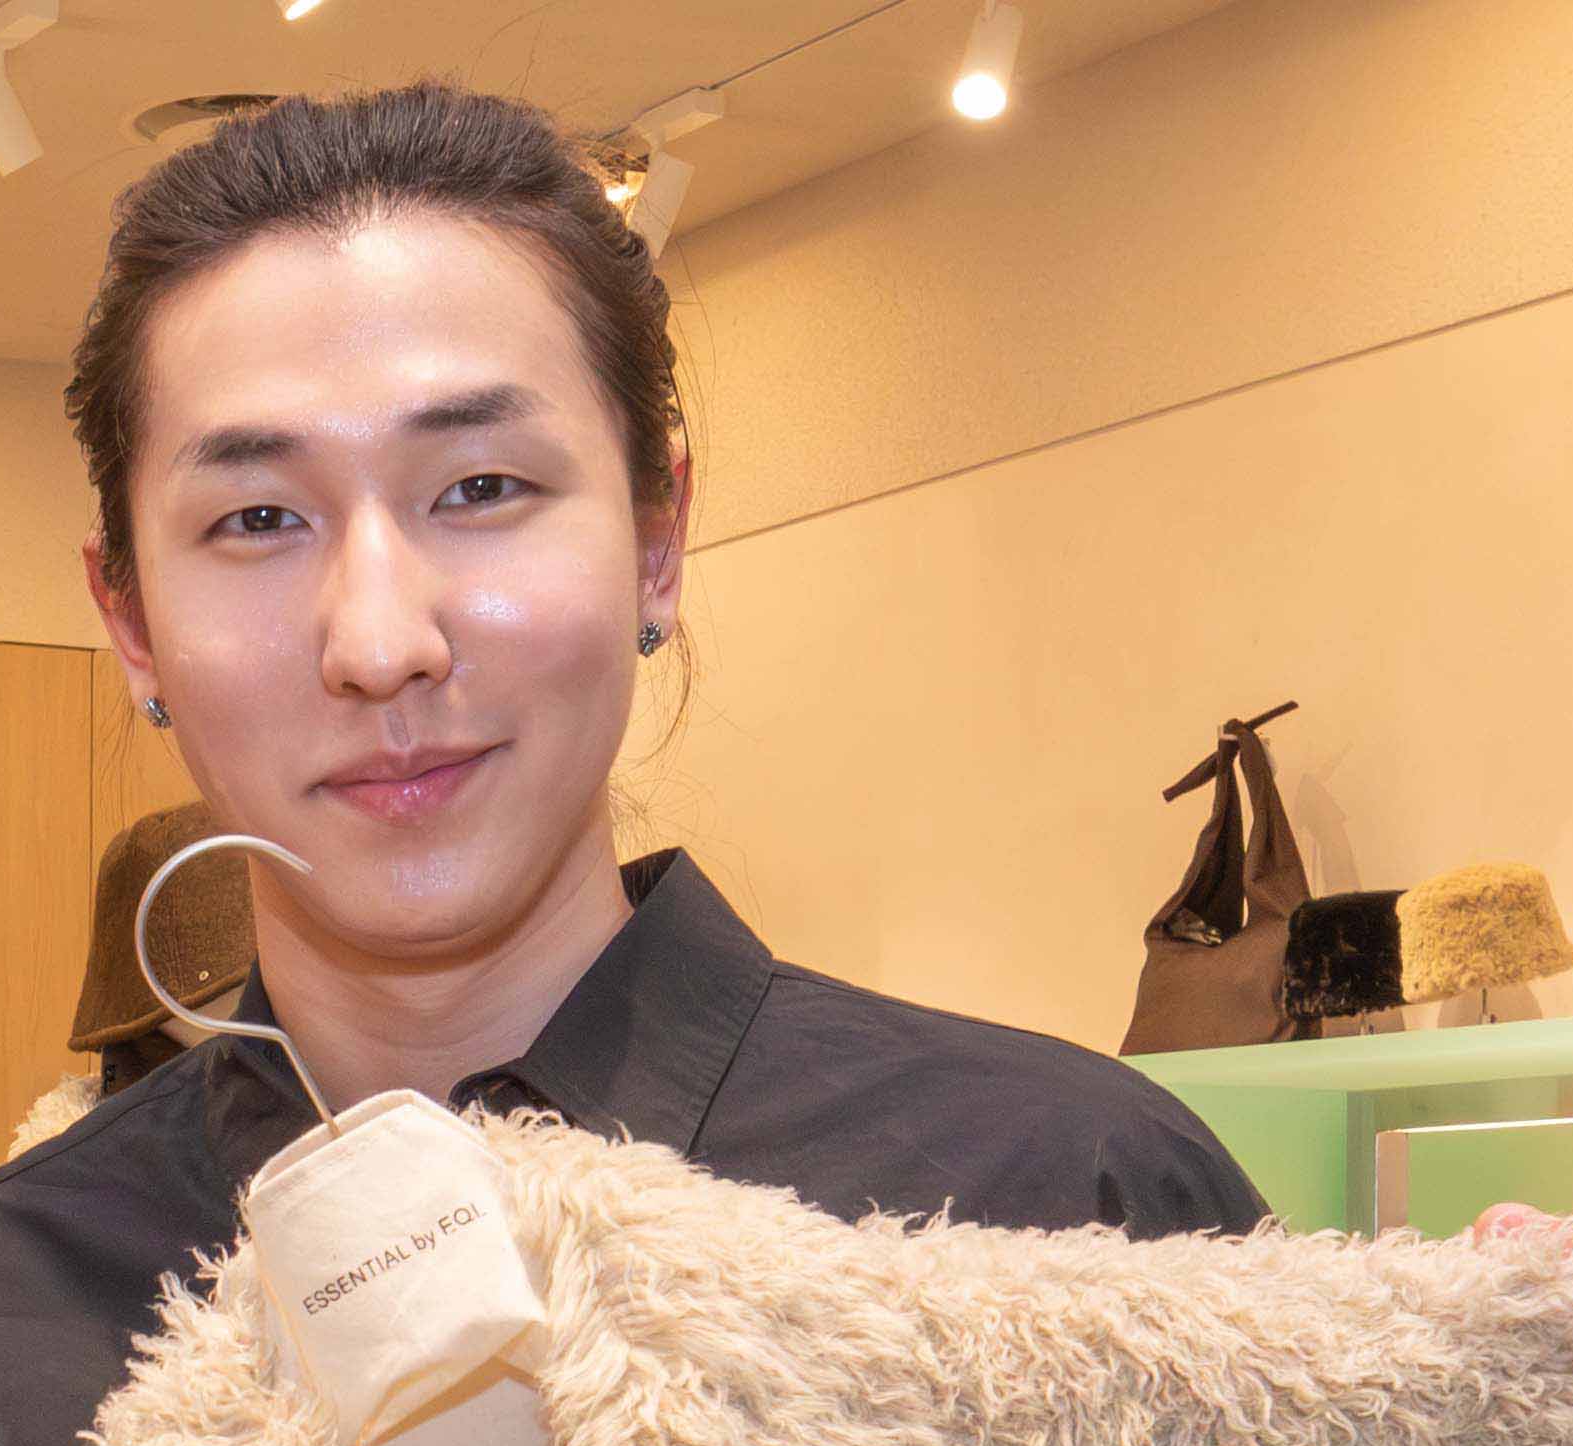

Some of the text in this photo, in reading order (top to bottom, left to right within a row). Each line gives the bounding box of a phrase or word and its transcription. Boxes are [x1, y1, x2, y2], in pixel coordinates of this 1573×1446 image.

[302, 1202, 488, 1316] ESSENTIAL by EQL
